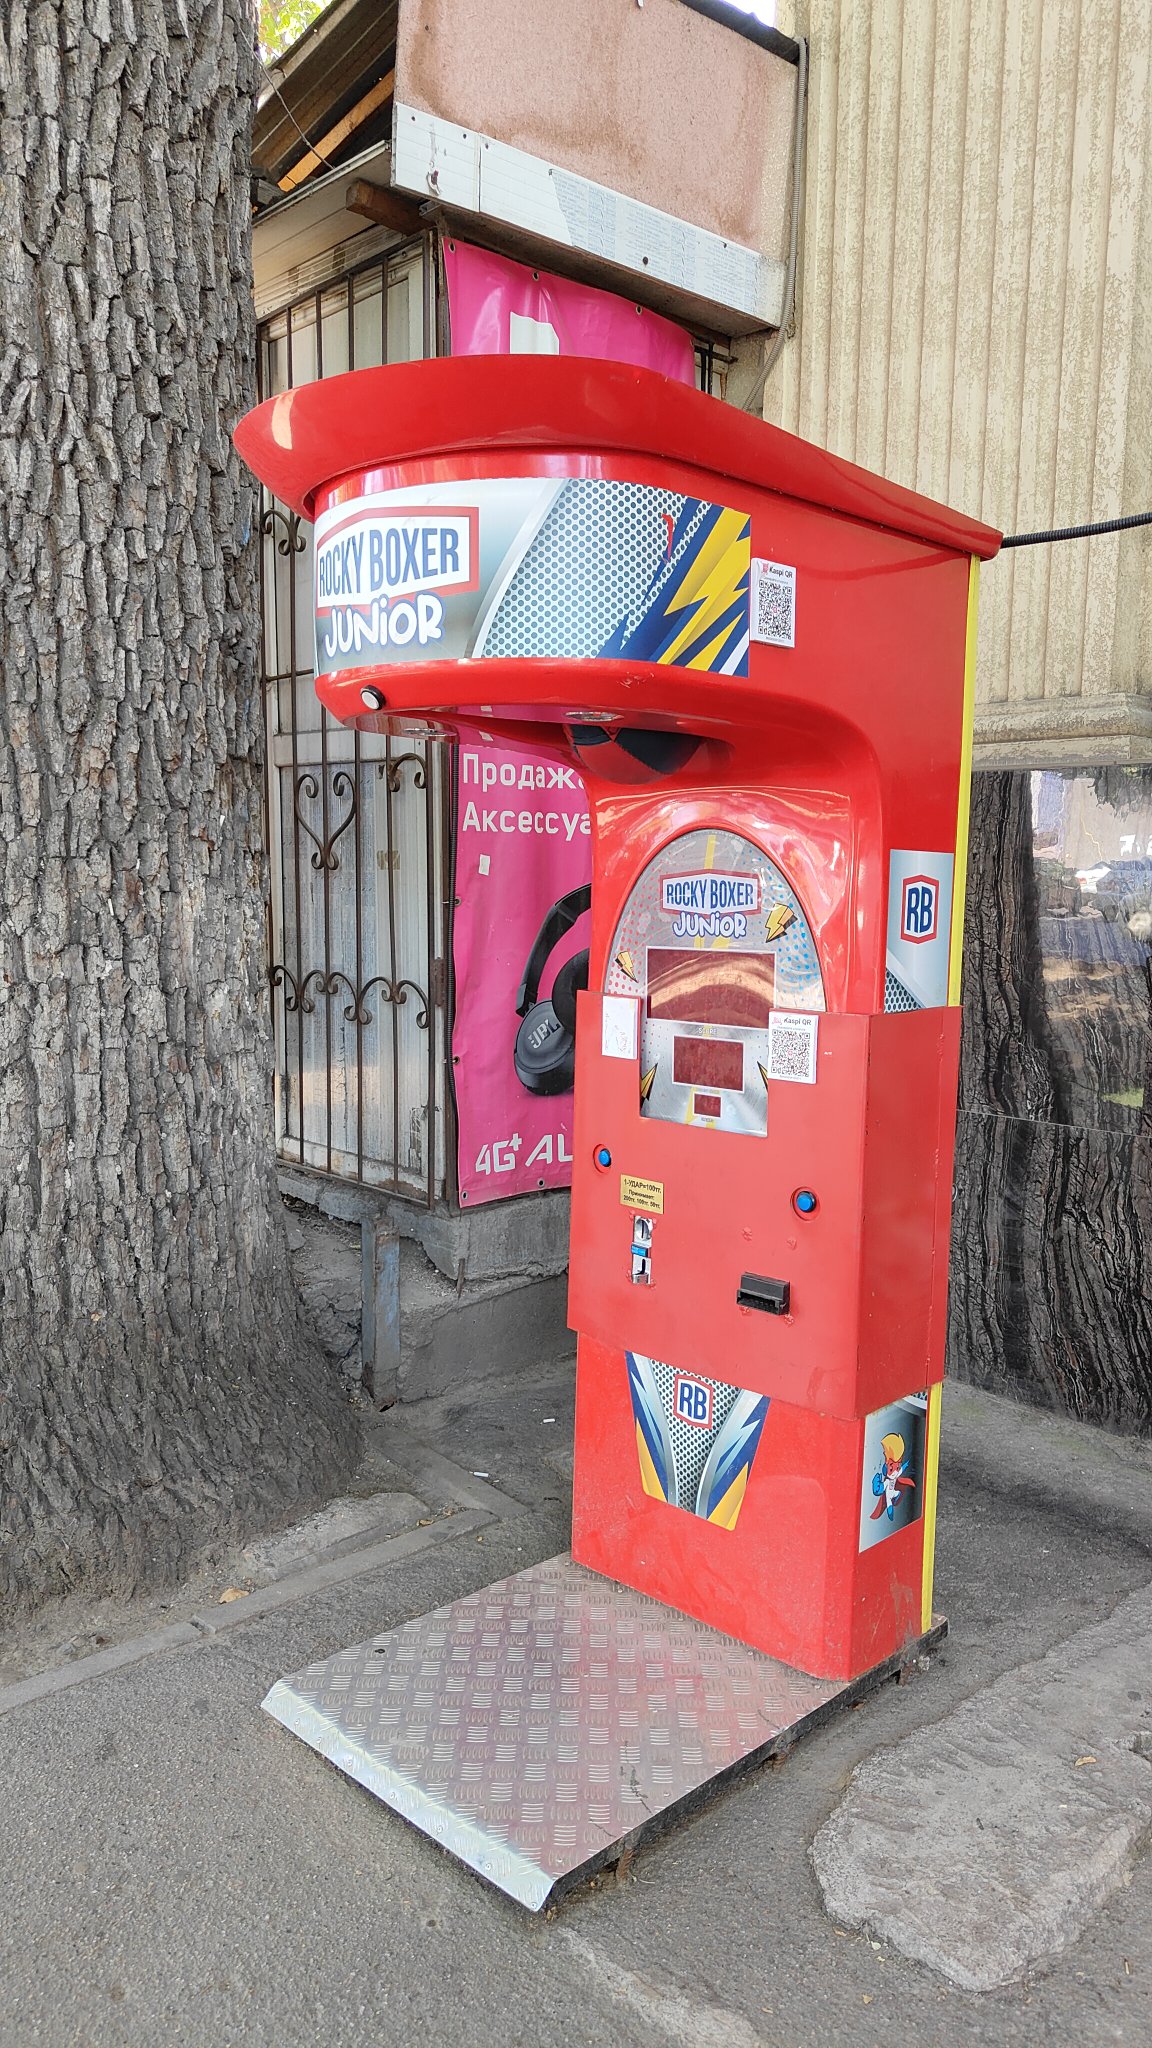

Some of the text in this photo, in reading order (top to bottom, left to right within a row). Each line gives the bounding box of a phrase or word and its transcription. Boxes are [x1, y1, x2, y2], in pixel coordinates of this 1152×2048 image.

[319, 528, 459, 597] ROCKY BOXER
[769, 566, 793, 578] Kaspi QR
[462, 801, 592, 841] Аксессуа
[666, 879, 754, 909] ROCKY BOXER
[906, 885, 933, 934] RB
[530, 1019, 560, 1049] JBL
[783, 1017, 812, 1026] Kaspi QR
[679, 1382, 707, 1421] RB
